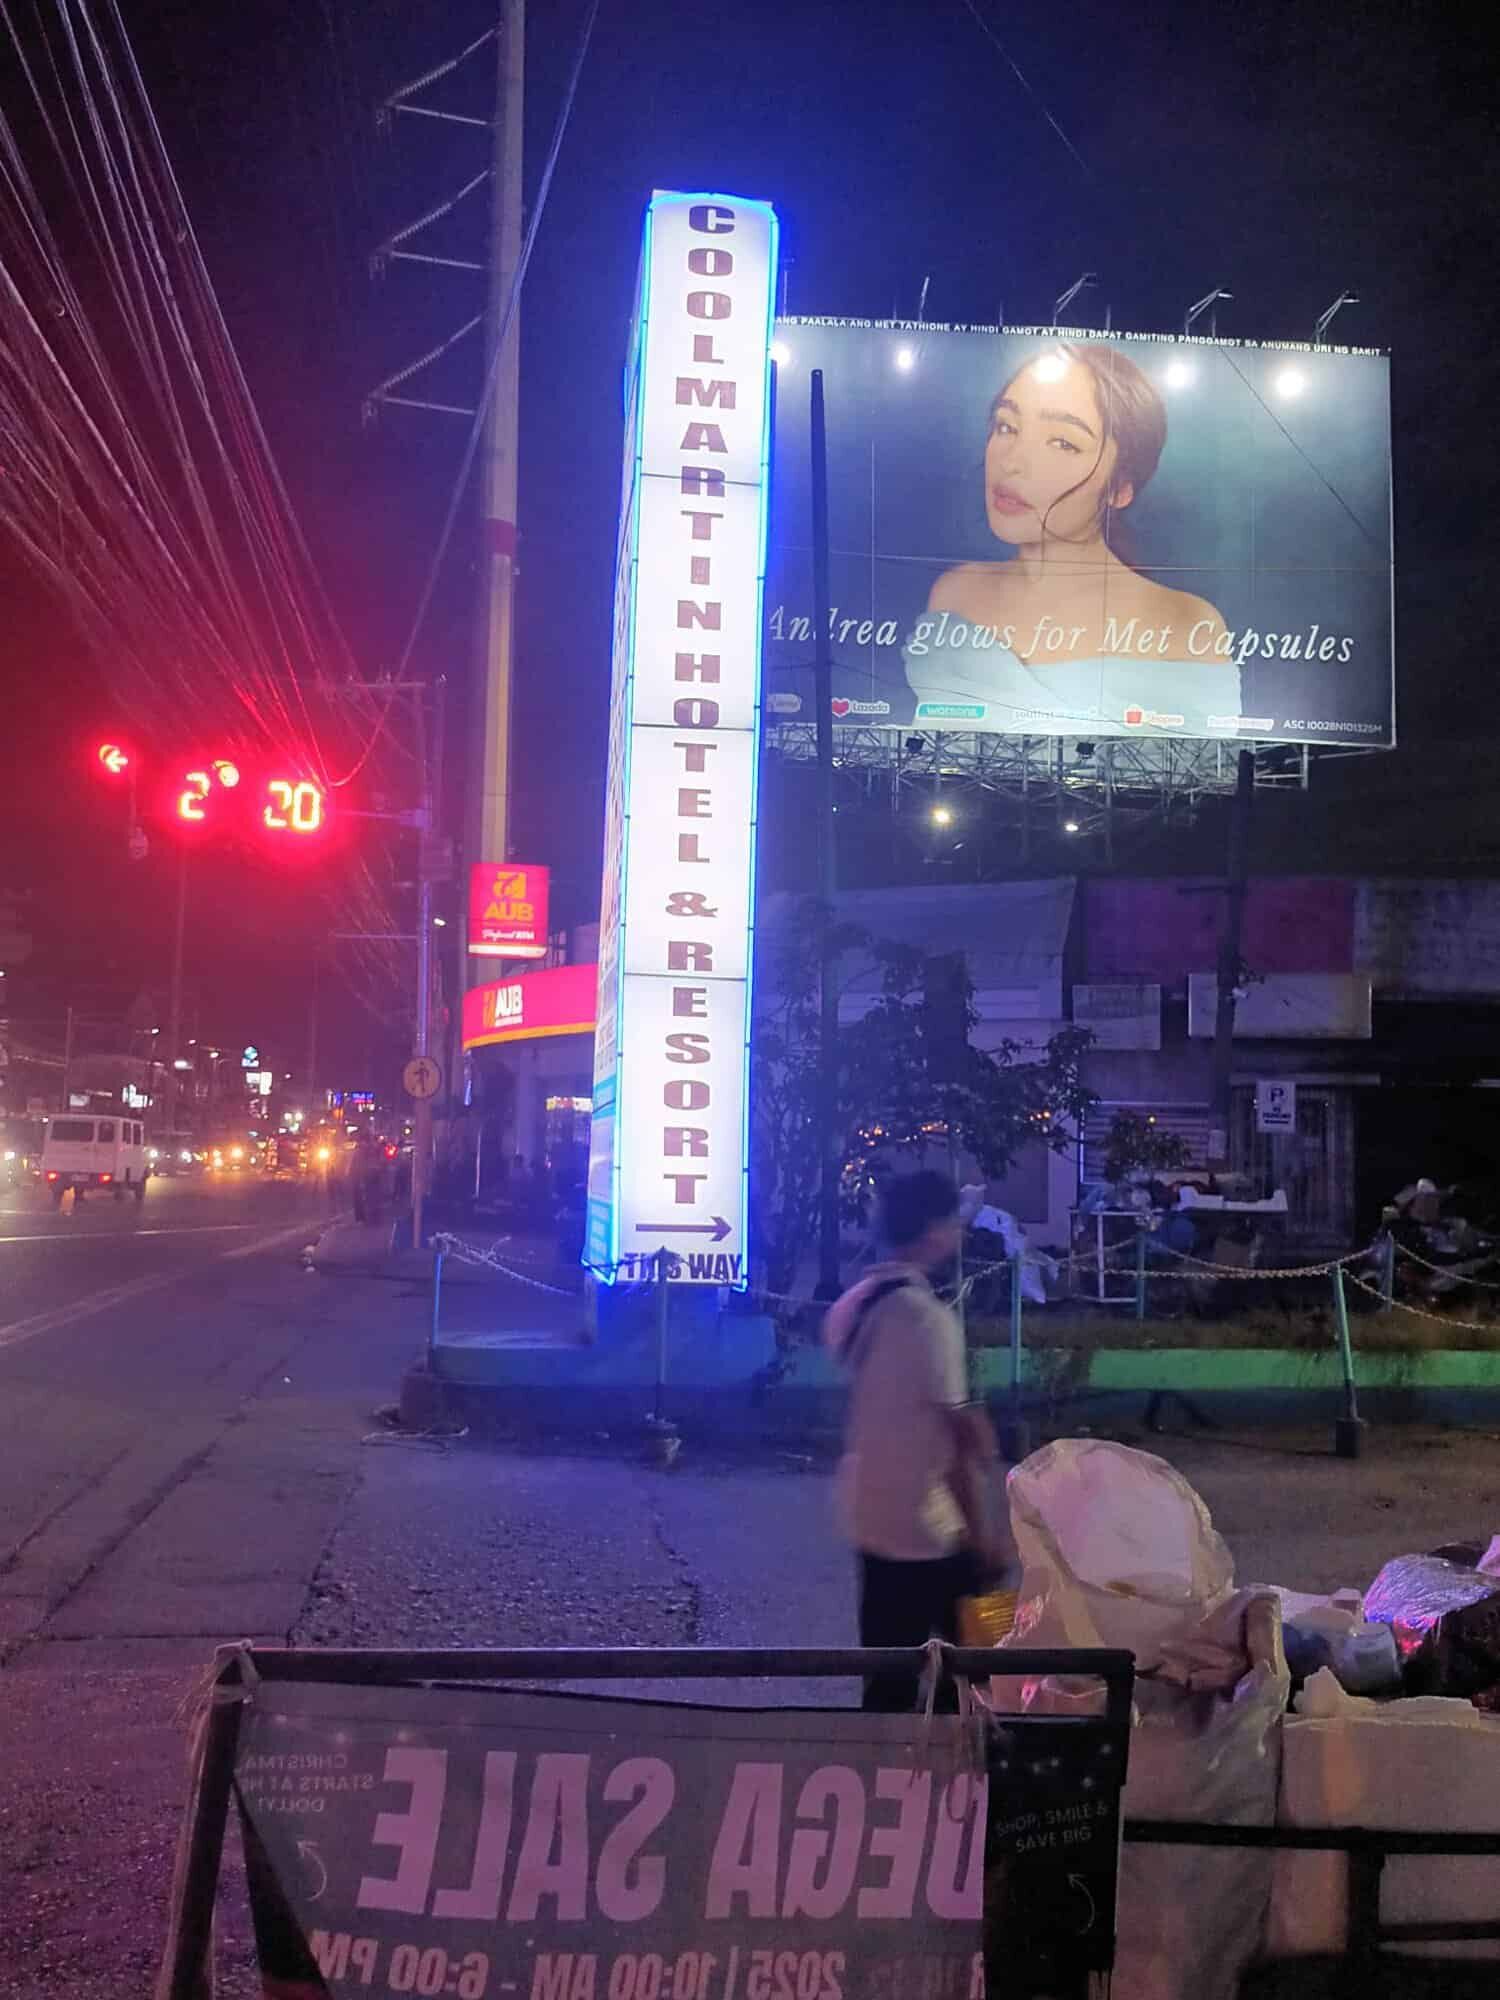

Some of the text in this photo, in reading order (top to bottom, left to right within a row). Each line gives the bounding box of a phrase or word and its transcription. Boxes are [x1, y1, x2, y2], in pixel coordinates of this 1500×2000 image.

[850, 319, 871, 329] ANG
[875, 319, 896, 330] MET
[900, 320, 949, 331] TATHIONE
[954, 323, 967, 332] AY
[970, 323, 999, 335] HINDI
[1002, 325, 1038, 336] GAMOT
[1058, 327, 1086, 338] HINDI
[1089, 328, 1121, 340] DAPAT
[1125, 331, 1175, 343] GAMITING
[1178, 334, 1241, 347] PANGGAMOT
[1260, 340, 1310, 353] ANUMANG
[1314, 343, 1330, 353] URI
[1334, 345, 1348, 354] NG
[1351, 346, 1380, 357] SAKIT
[907, 612, 1016, 656] glows
[1020, 615, 1088, 659] for
[1097, 616, 1173, 654] Met
[1187, 618, 1354, 665] Capsules
[1283, 719, 1304, 730] ASC
[673, 652, 721, 864] HOTEL
[264, 780, 321, 831] 20
[484, 902, 534, 921] AUB
[665, 891, 718, 918] &
[496, 984, 523, 1017] AUB
[663, 940, 713, 1204] RESORT
[688, 1252, 743, 1280] WAY
[1045, 1803, 1091, 1826] SMILE
[1015, 1825, 1092, 1854] SAVE BIG
